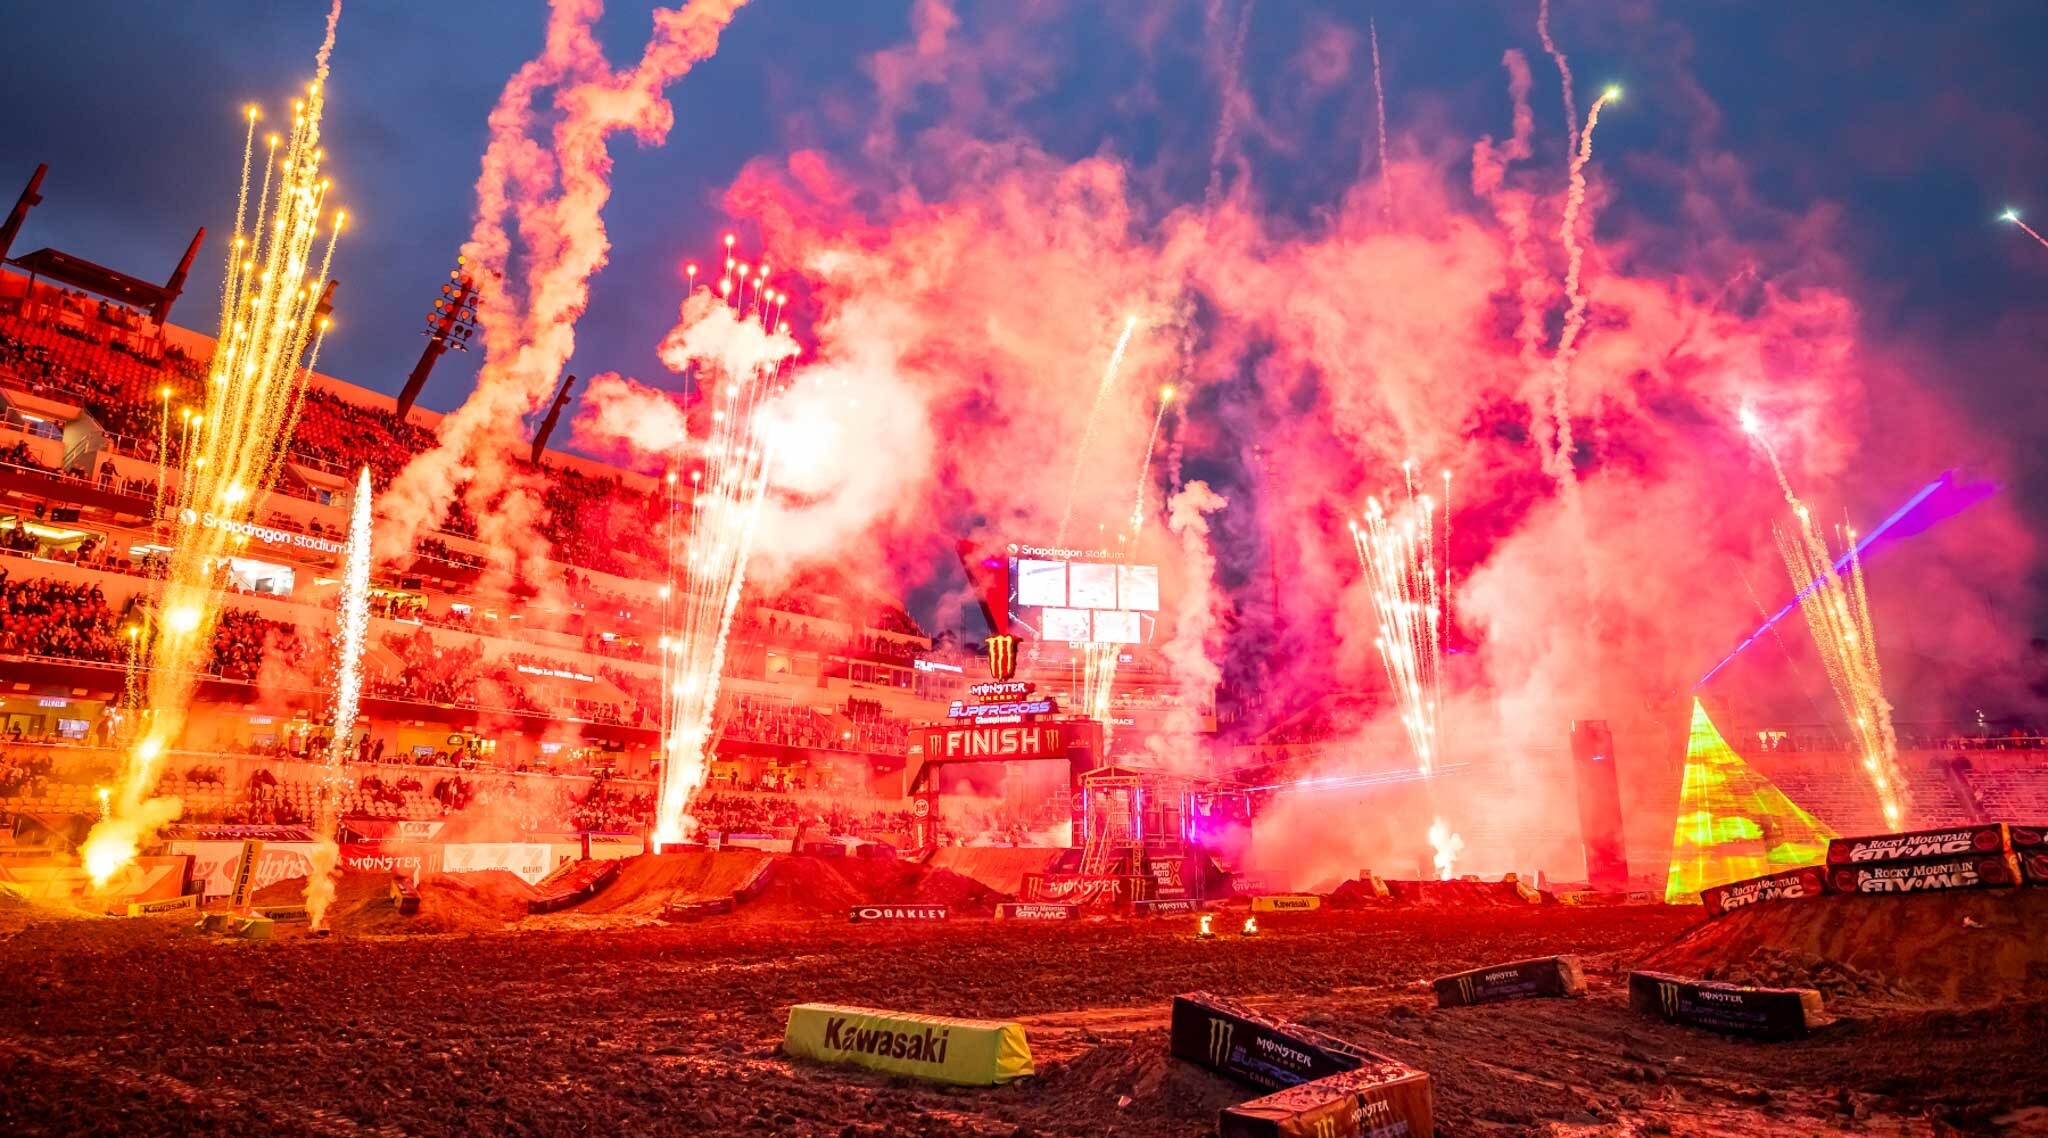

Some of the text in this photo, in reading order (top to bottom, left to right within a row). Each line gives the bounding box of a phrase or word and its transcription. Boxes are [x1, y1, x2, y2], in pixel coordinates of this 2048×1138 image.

[203, 513, 347, 555] Snapdragon stadium
[1022, 544, 1125, 559] Snapdragon stadium
[972, 683, 1026, 695] MONSTER
[949, 702, 1050, 717] SUPERCROSS
[947, 728, 1041, 756] FINISH
[404, 822, 431, 834] COX
[1869, 832, 1972, 849] ROCKY MOUNTAIN
[349, 855, 422, 872] MONSTER
[1874, 862, 1973, 878] ROCKY MOUNTAIN
[235, 844, 254, 905] LEADER
[1049, 879, 1122, 901] MONSTER
[1731, 876, 1800, 897] ROCKY MOUNTAIN
[143, 900, 191, 914] Kawasaki
[884, 909, 946, 919] OAKLEY
[1485, 969, 1519, 981] MONSTER
[1698, 991, 1744, 1004] MONSTER
[824, 1016, 949, 1064] Kawasaki
[1256, 1036, 1312, 1068] MONSTER
[1351, 1100, 1389, 1123] MONSTER
